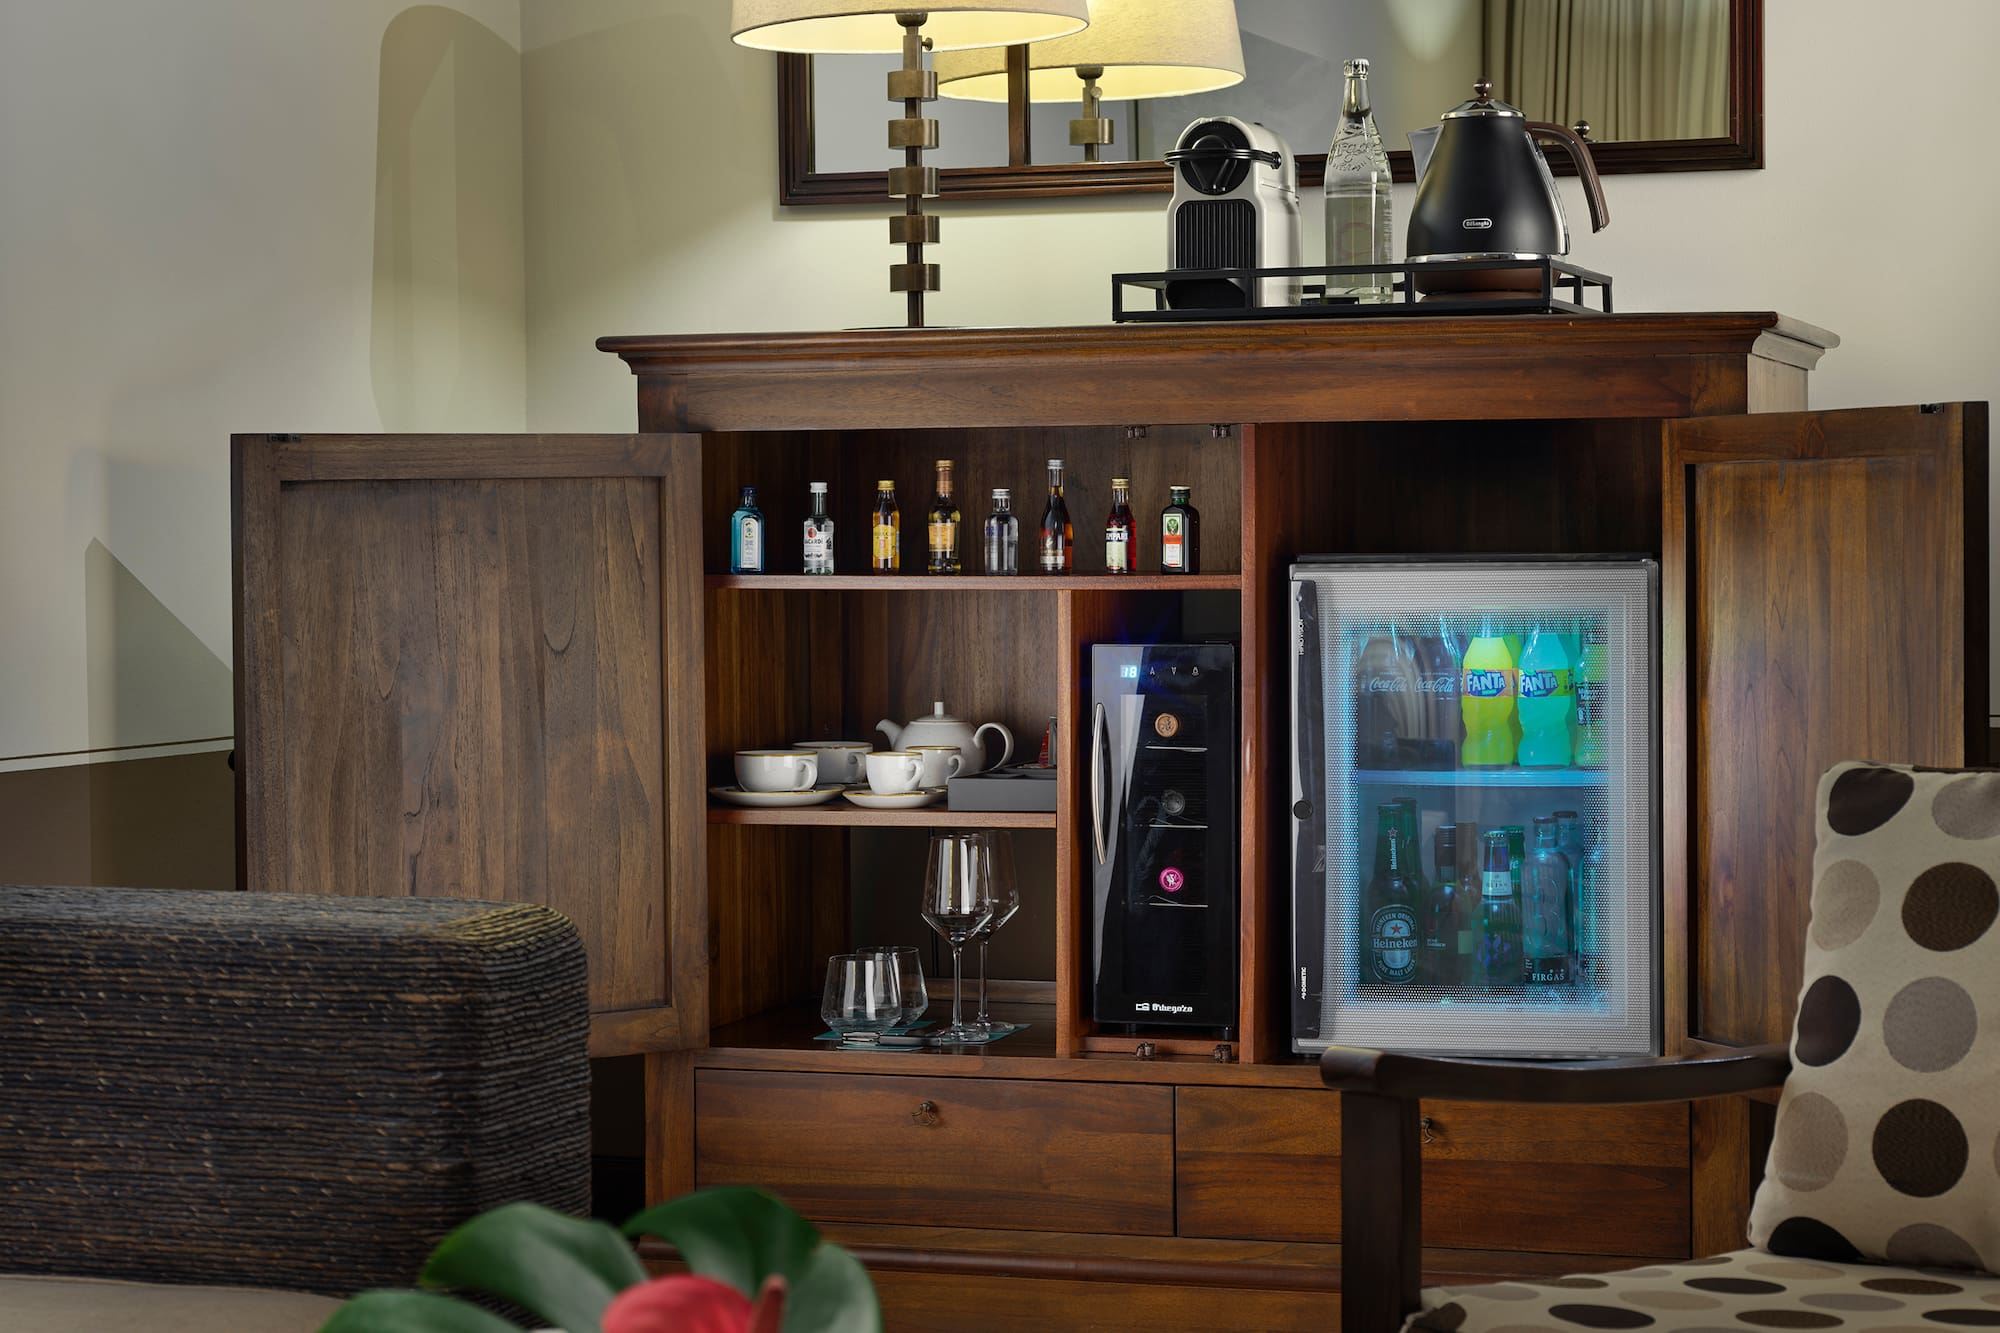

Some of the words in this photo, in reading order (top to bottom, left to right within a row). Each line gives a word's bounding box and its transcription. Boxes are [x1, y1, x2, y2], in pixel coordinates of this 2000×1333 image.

[1123, 666, 1138, 678] 18
[1466, 672, 1506, 692] FANTA
[1520, 672, 1559, 692] FANTA
[1373, 938, 1418, 949] Heineken
[1532, 973, 1565, 982] FIRGAS
